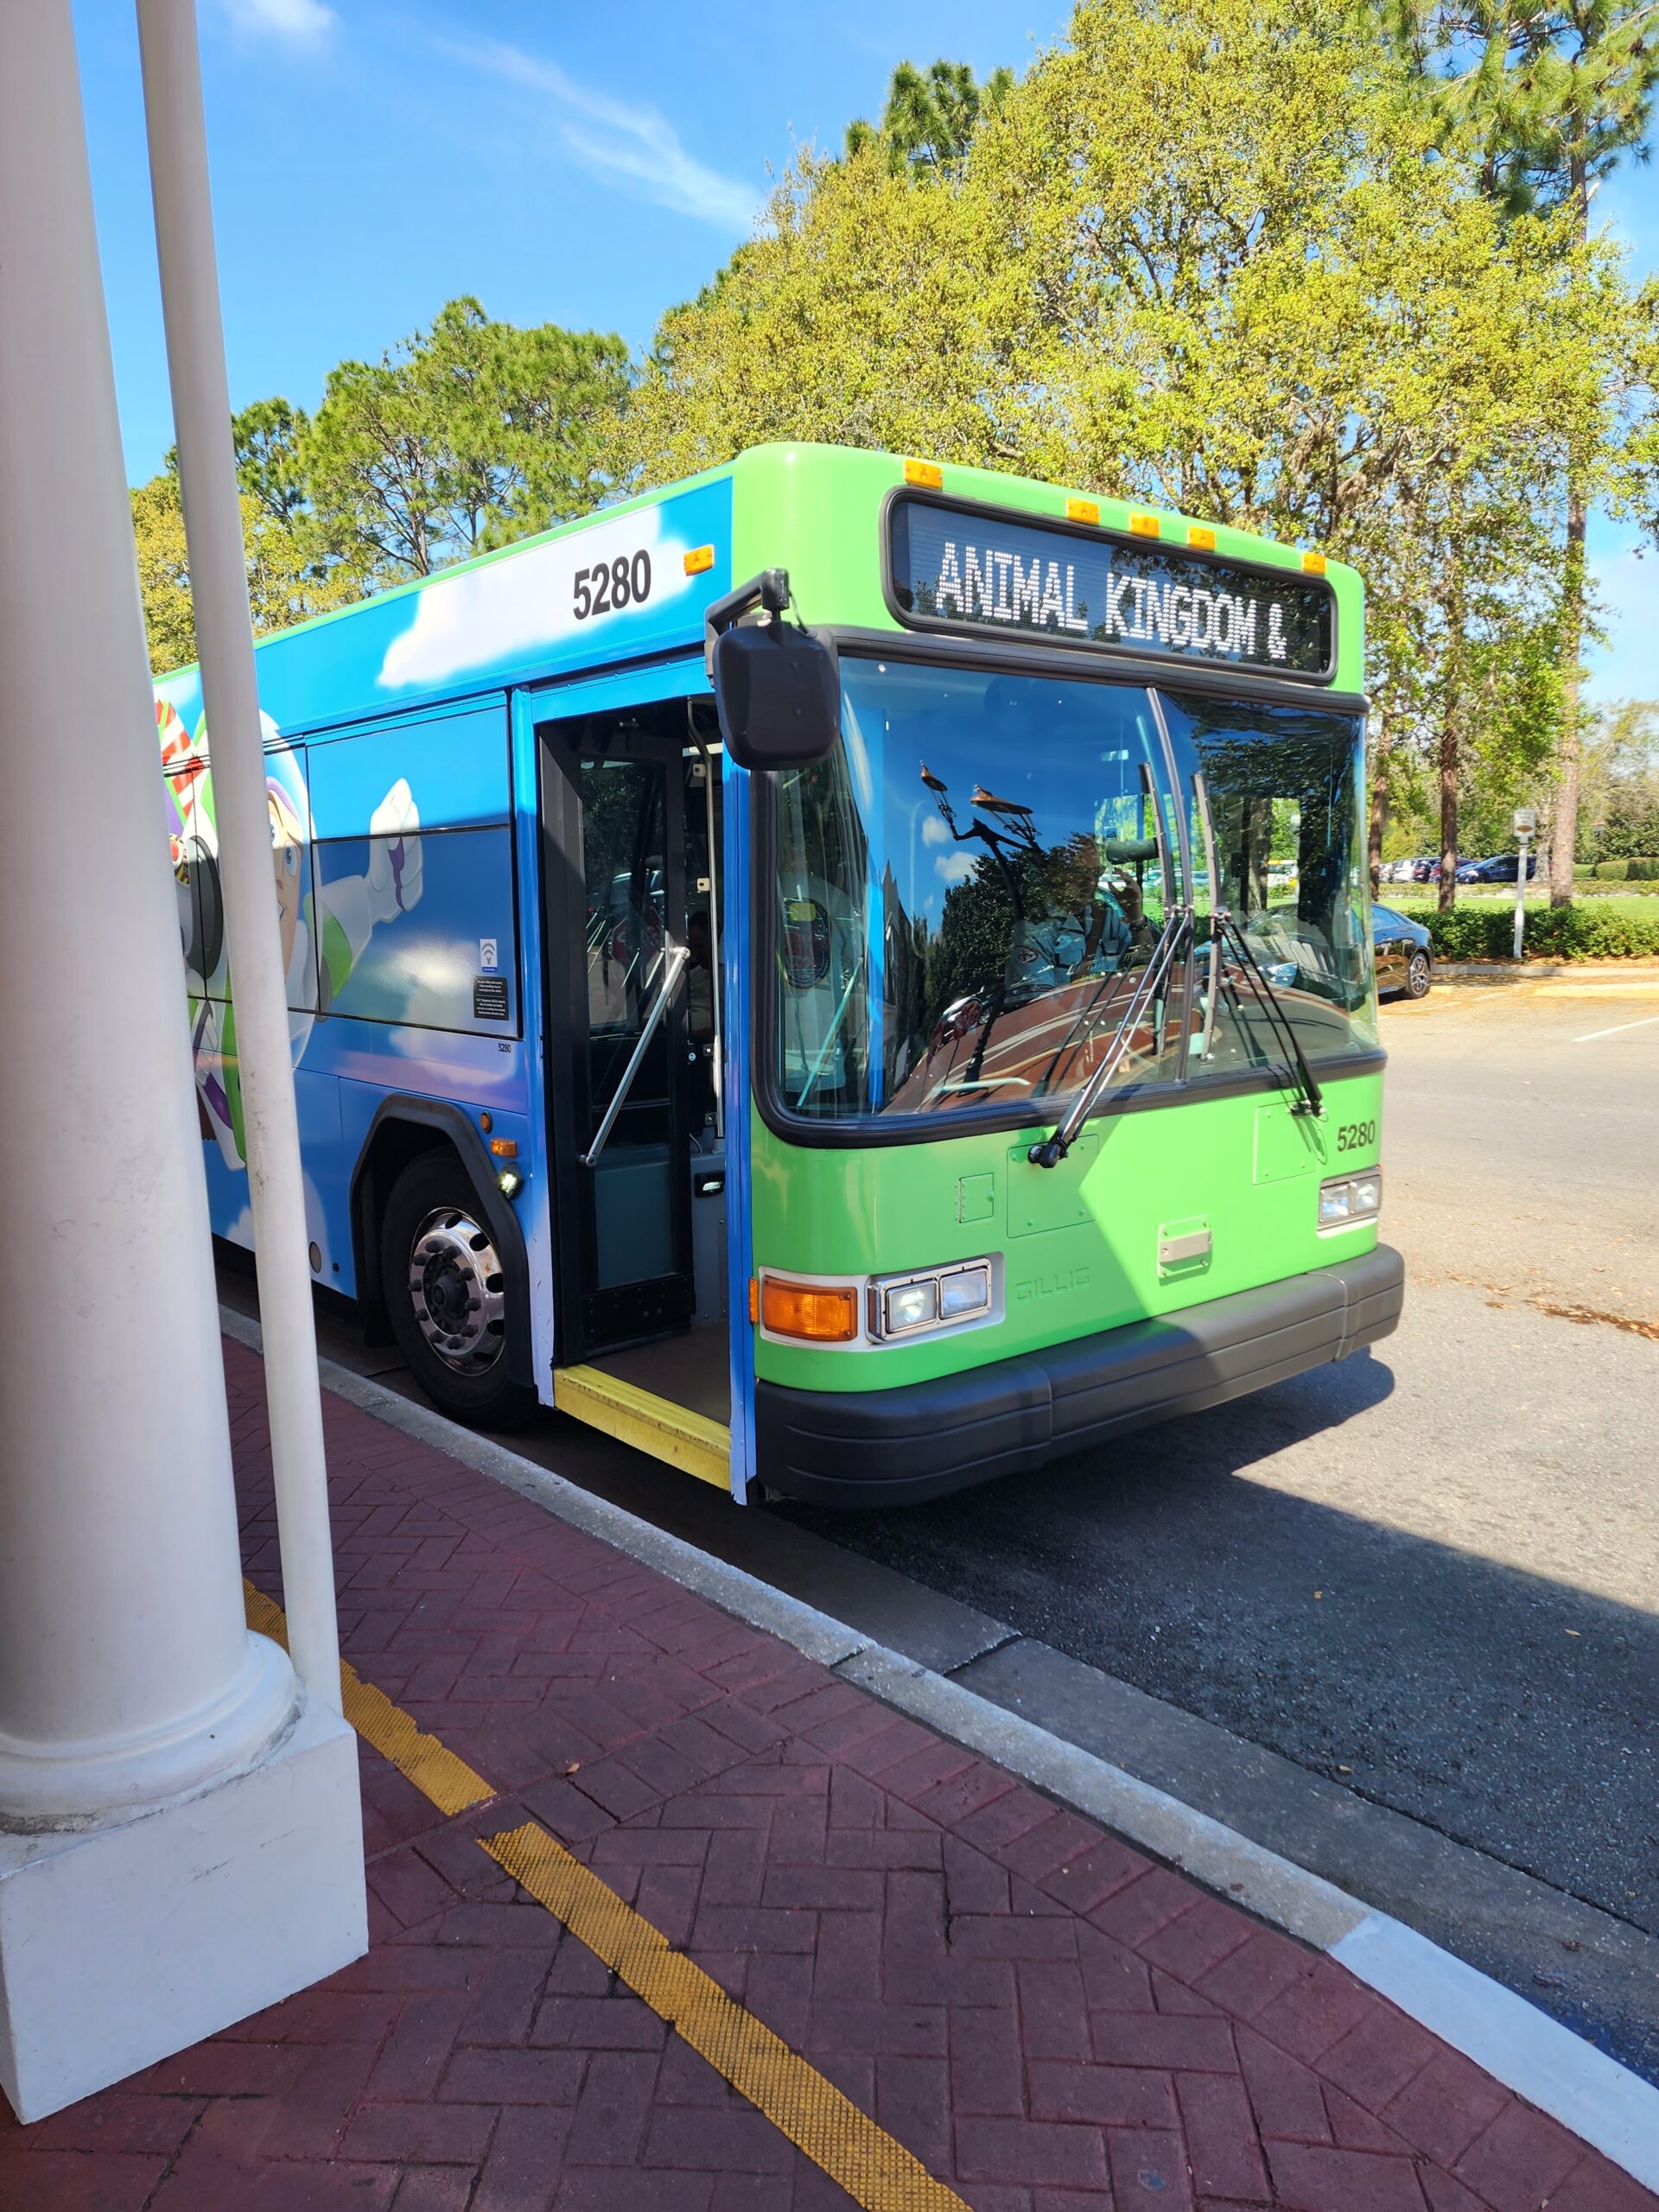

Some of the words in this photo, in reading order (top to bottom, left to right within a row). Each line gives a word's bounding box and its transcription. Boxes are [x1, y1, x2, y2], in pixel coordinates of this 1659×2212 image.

[573, 549, 652, 620] 5280
[936, 542, 1089, 631] ANIMAL
[1105, 572, 1257, 656] KINGDOM
[498, 1042, 512, 1053] 5280
[1337, 1119, 1376, 1153] 5280
[1015, 1266, 1091, 1300] GILLIG
